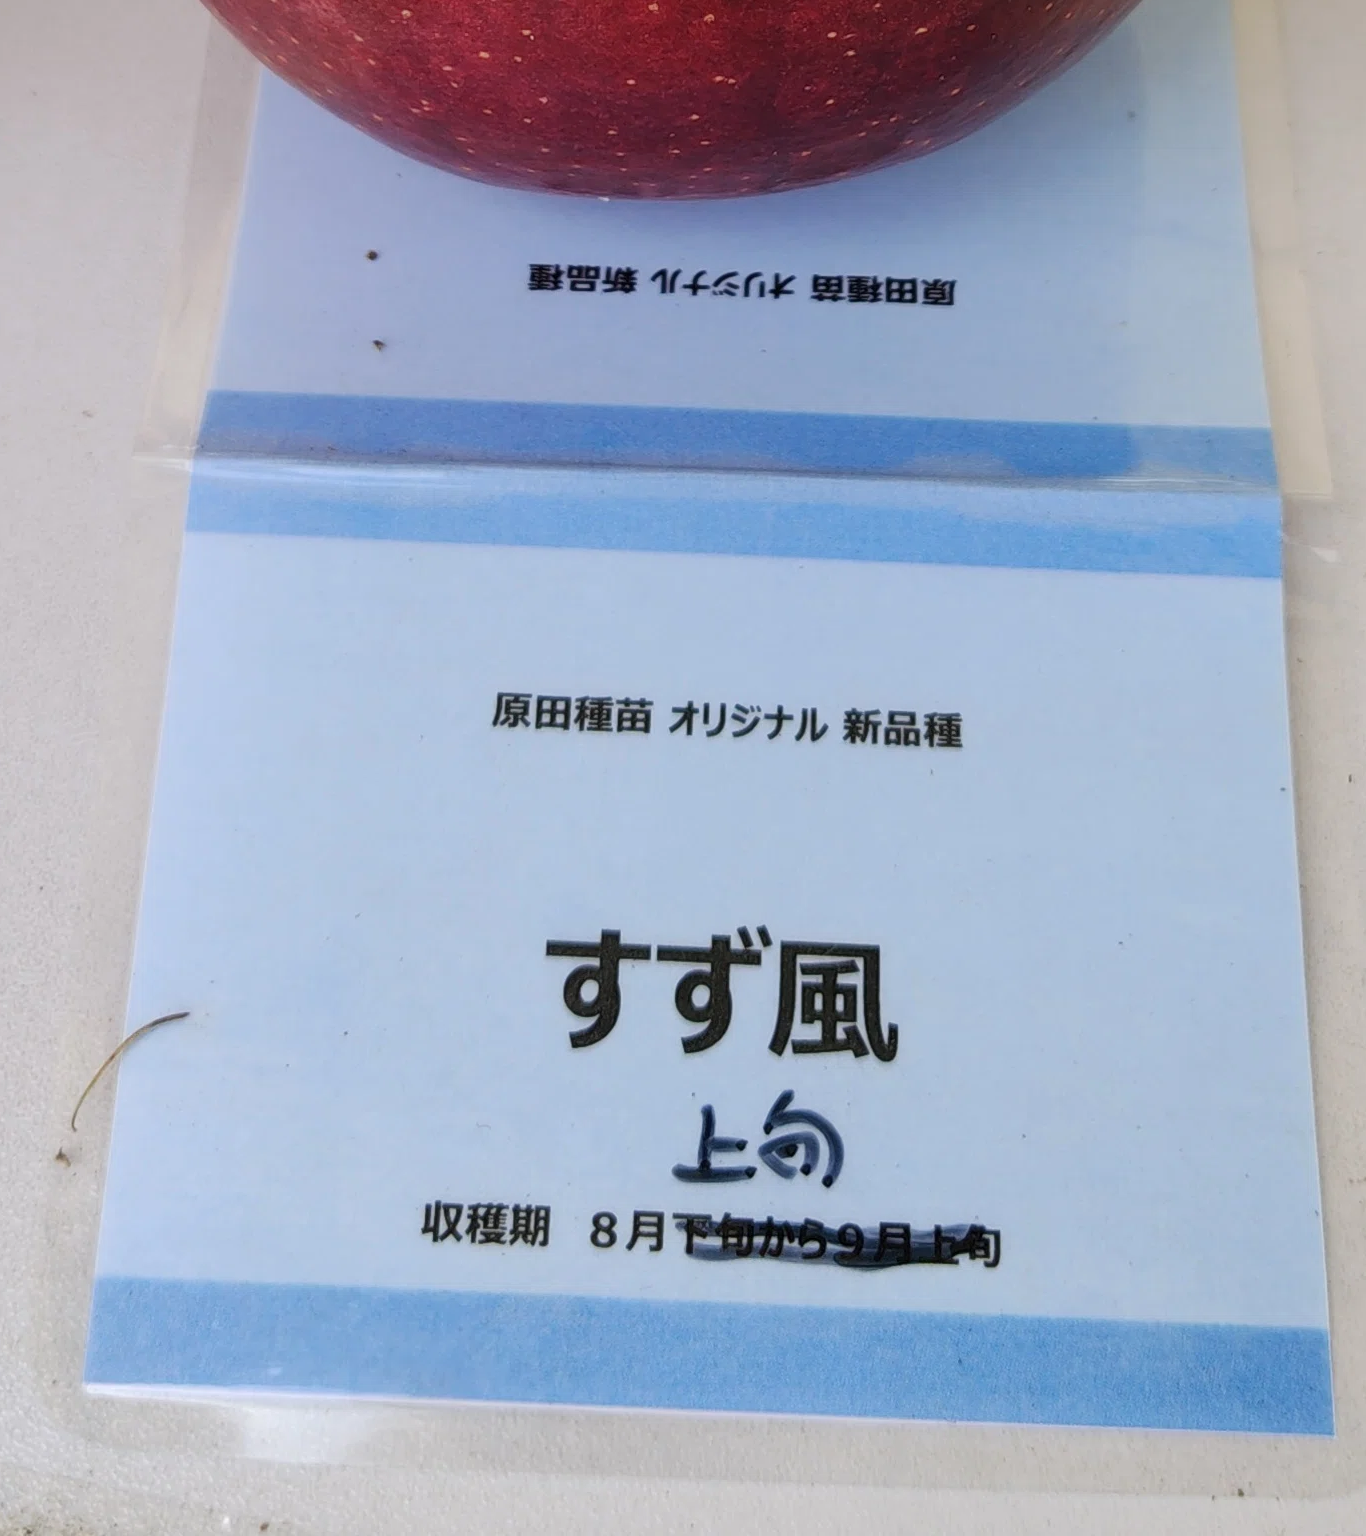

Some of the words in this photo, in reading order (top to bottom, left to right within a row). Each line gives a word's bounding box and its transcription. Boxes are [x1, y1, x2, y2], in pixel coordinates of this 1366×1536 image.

[526, 263, 639, 295] 新品種
[649, 267, 798, 300] オリジナル
[810, 272, 958, 307] 原田種苗
[491, 691, 654, 735] 原田種苗
[668, 699, 829, 743] オリジナル
[842, 707, 964, 749] 新品種
[545, 925, 899, 1063] すず風
[672, 1089, 845, 1188] 上旬
[420, 1200, 552, 1247] 収穫期
